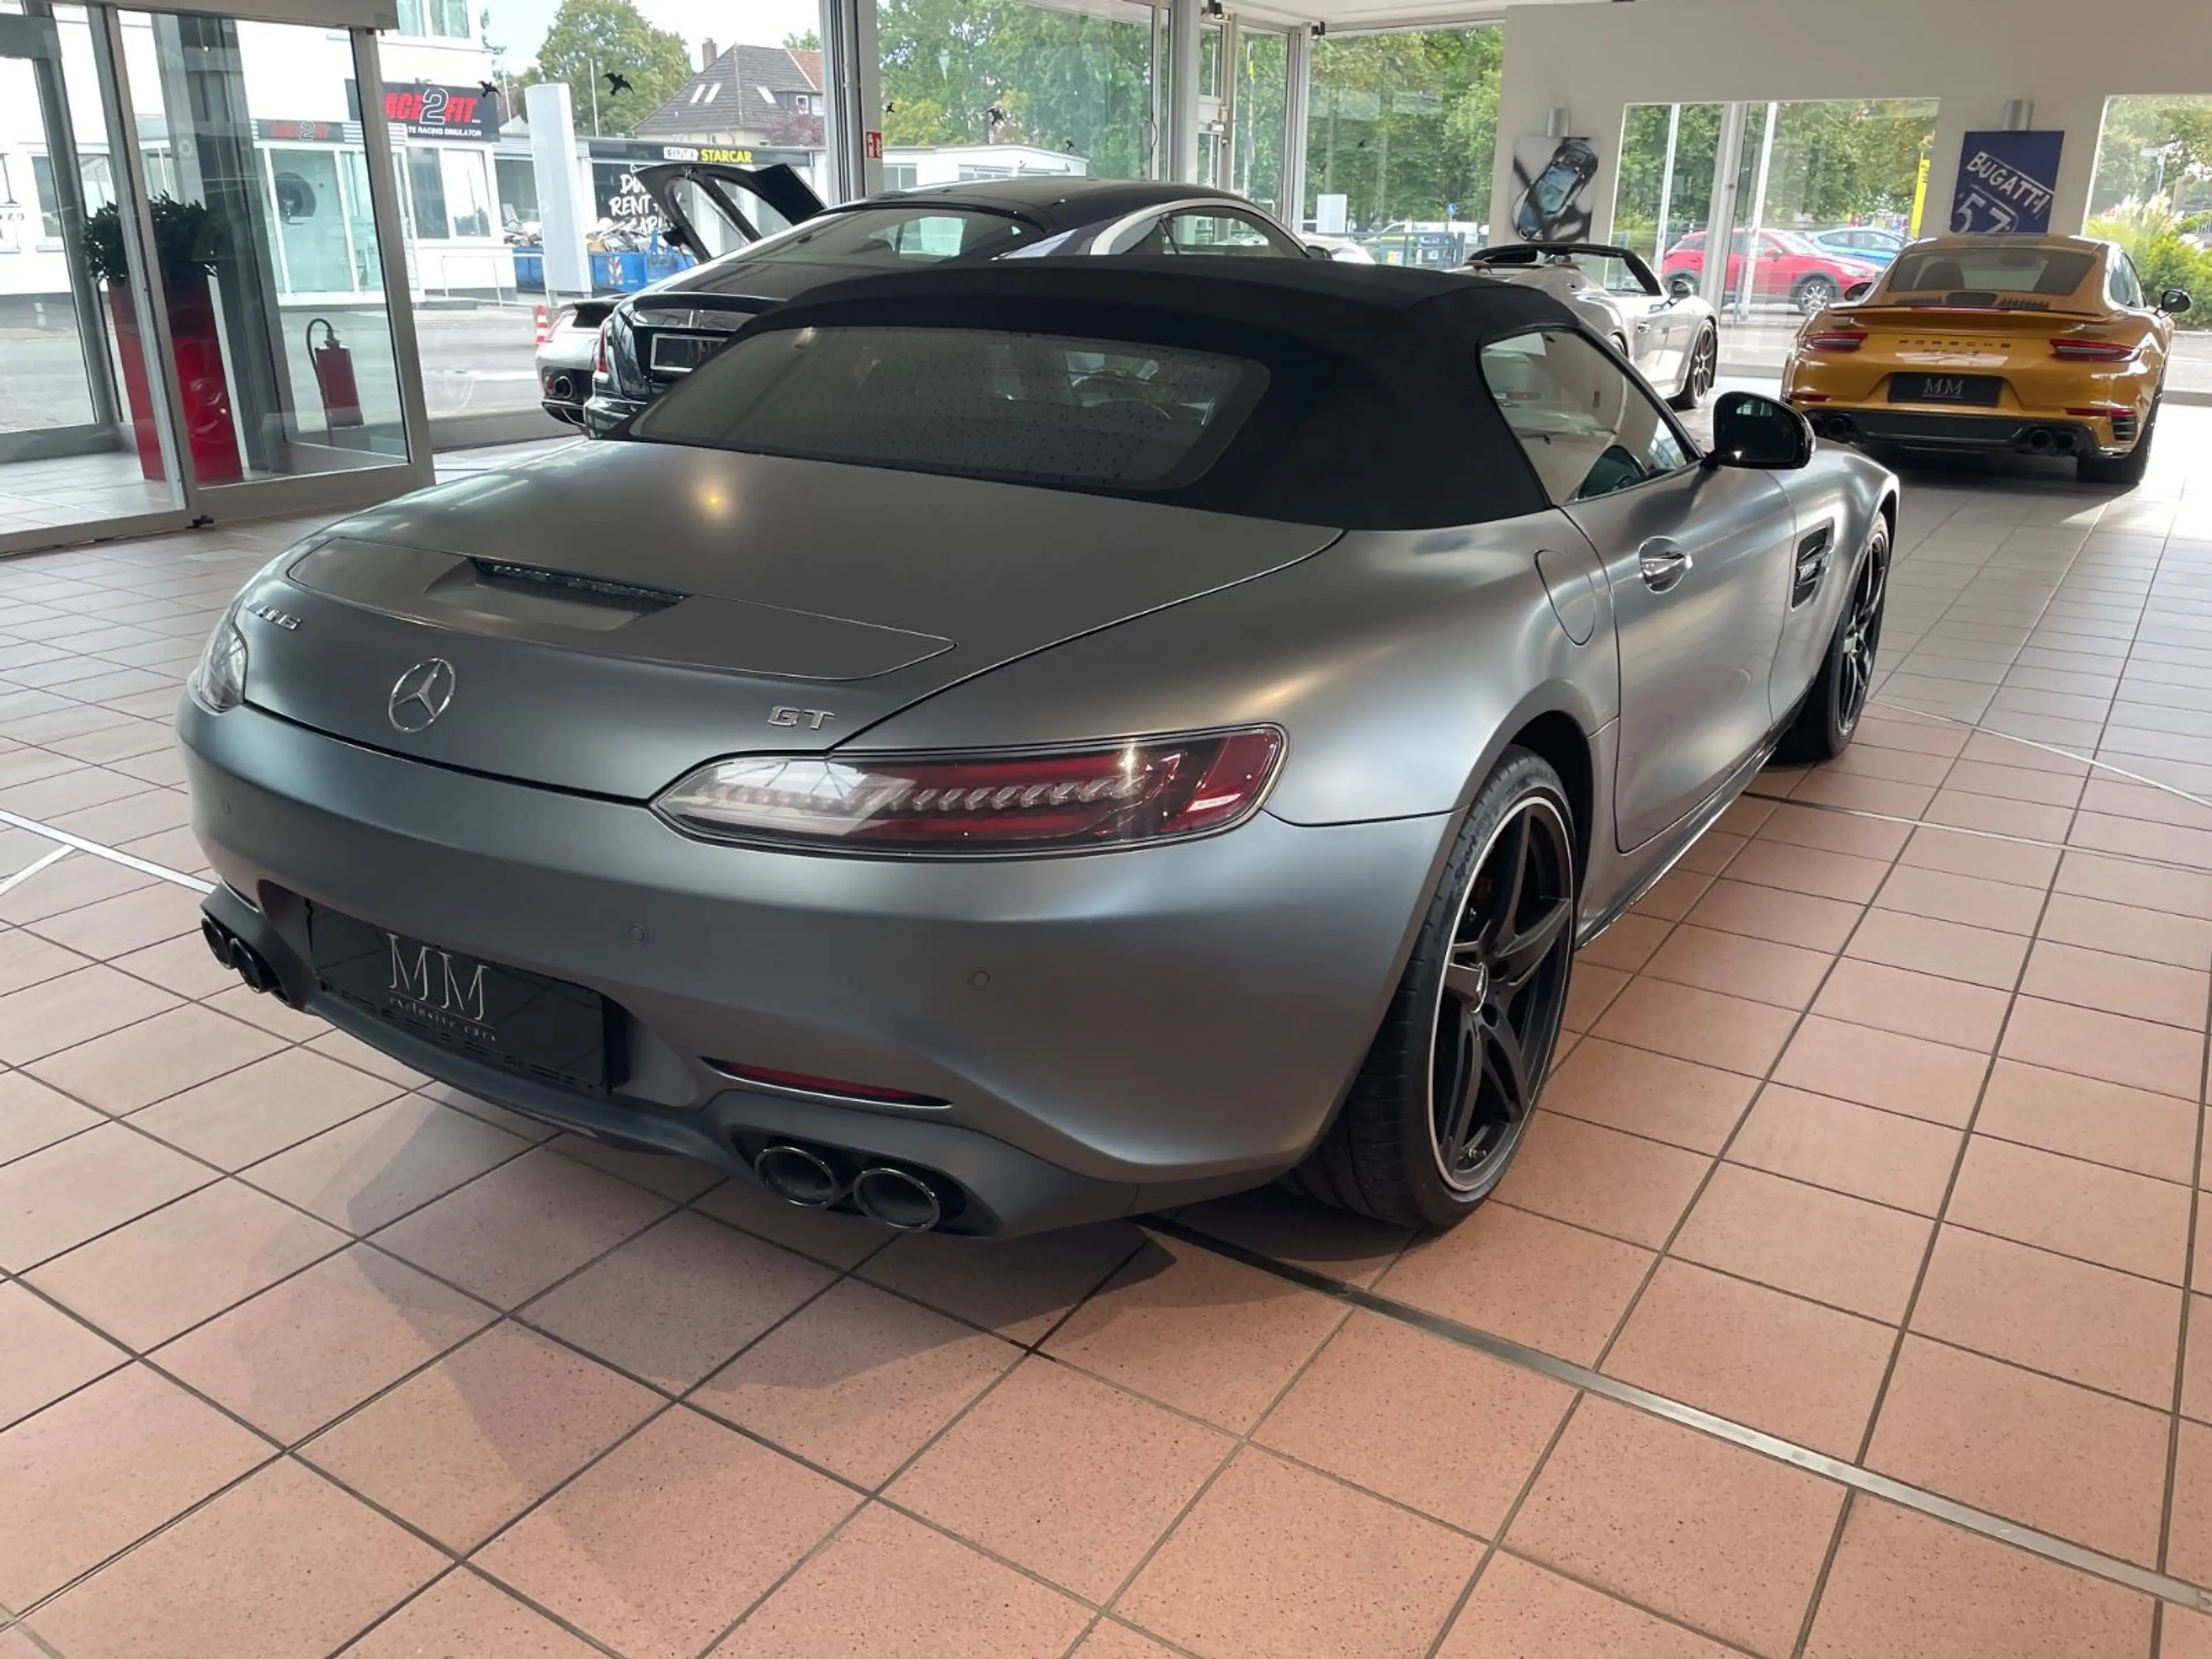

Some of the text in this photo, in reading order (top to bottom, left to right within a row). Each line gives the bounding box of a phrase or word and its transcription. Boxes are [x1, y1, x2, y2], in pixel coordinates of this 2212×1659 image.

[700, 148, 752, 163] STARCAR
[1967, 151, 2050, 213] BUGATTI
[608, 194, 652, 216] RENT
[1956, 194, 2011, 233] 57
[1899, 339, 2011, 348] PORSCHE
[1923, 378, 1965, 396] MM
[767, 706, 836, 730] GT
[387, 932, 489, 1020] MM
